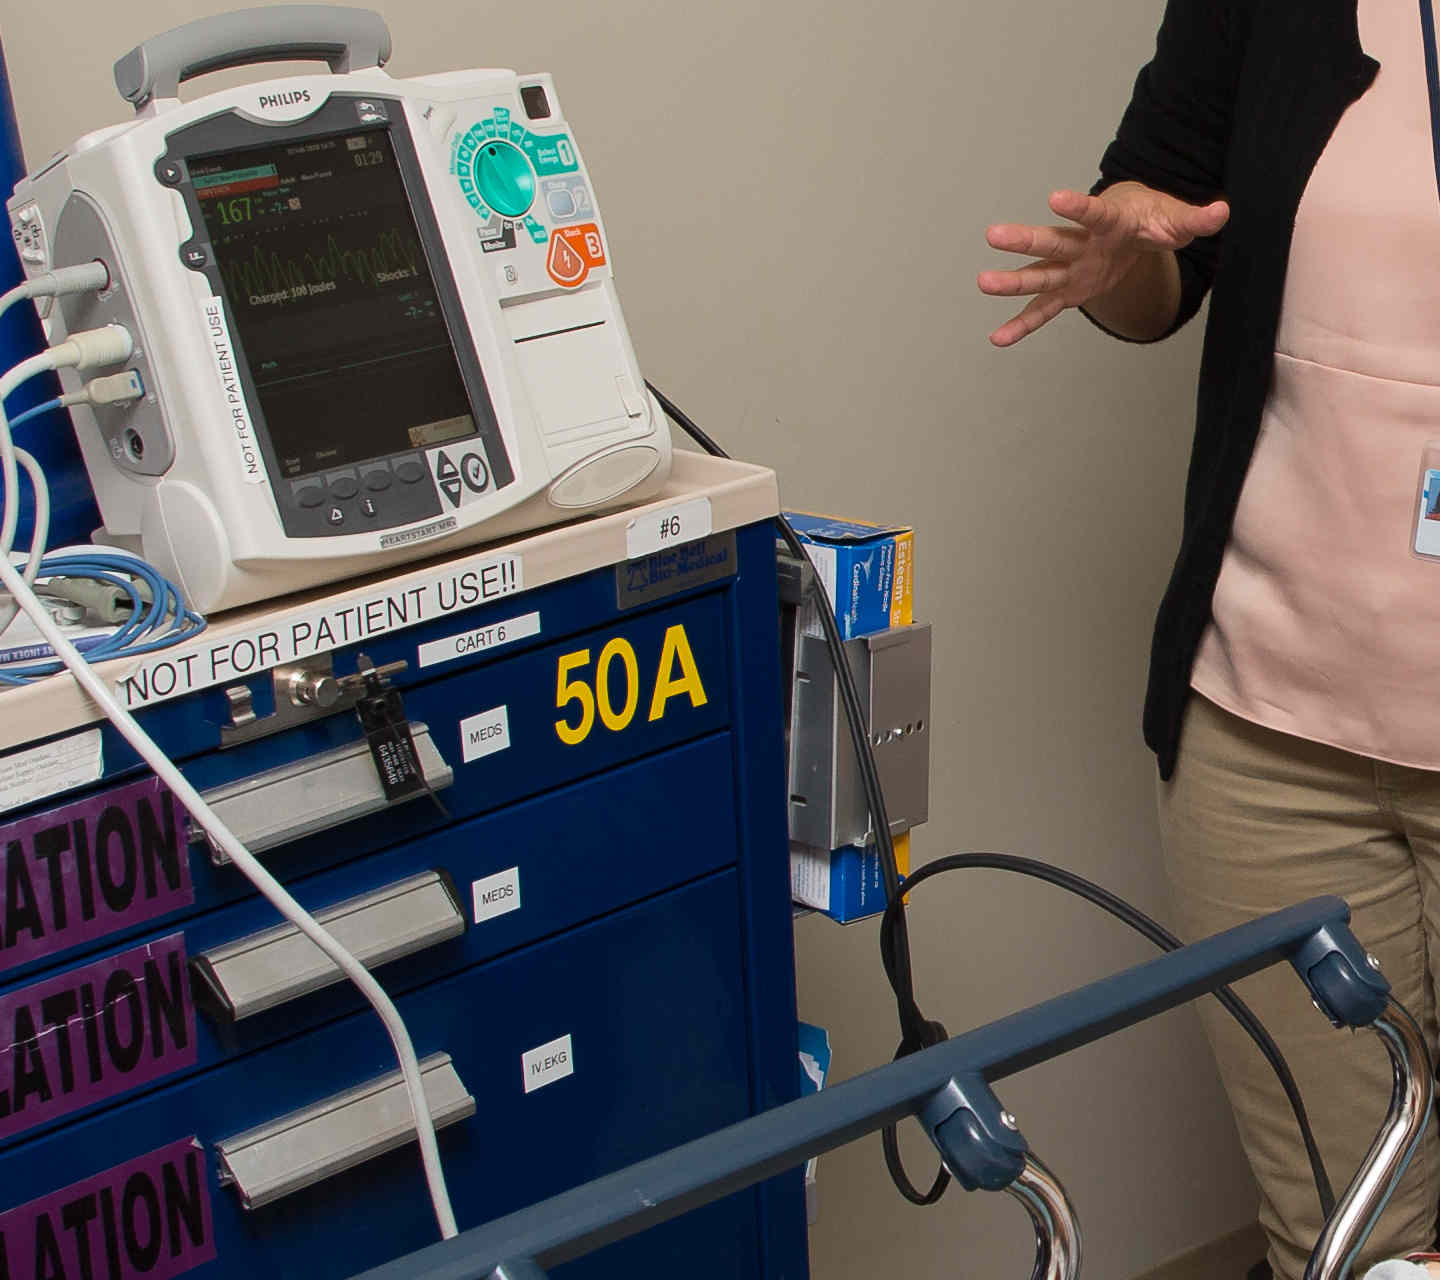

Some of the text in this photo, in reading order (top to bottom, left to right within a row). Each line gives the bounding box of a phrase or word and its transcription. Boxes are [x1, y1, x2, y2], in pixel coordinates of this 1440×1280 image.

[259, 90, 312, 108] PHILIPS
[216, 197, 252, 225] 167
[585, 234, 602, 258] 3
[249, 290, 290, 306] Charged:
[207, 305, 258, 473] NOT FOR PATIENT USE
[659, 515, 681, 539] #6
[125, 560, 517, 706] NOT FOR PATIENT USE!!
[455, 626, 507, 654] CART 6
[470, 723, 503, 745] MEDS
[481, 883, 514, 906] MEDS
